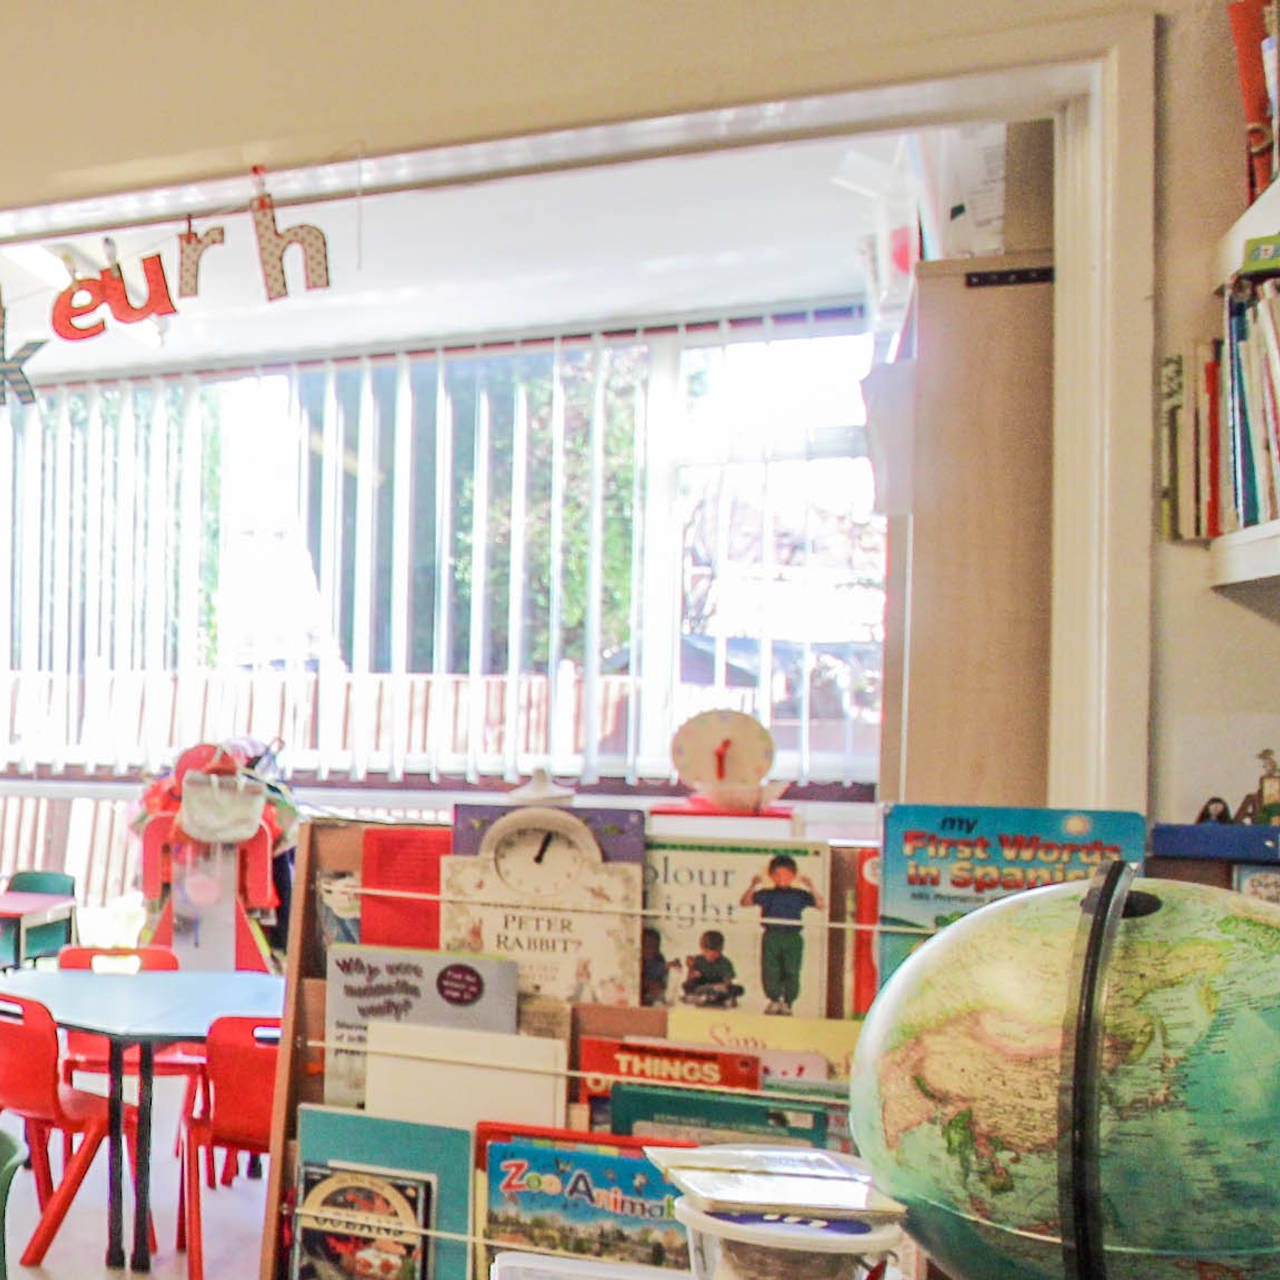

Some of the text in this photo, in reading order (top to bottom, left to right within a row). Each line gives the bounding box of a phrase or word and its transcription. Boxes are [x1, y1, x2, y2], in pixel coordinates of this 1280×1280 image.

[940, 815, 979, 834] my
[902, 829, 1123, 863] First Words
[907, 859, 941, 887] in
[503, 913, 575, 934] PETER
[495, 933, 584, 955] RABBIT?
[613, 1052, 722, 1084] THINGS
[499, 1159, 564, 1196] Zoo
